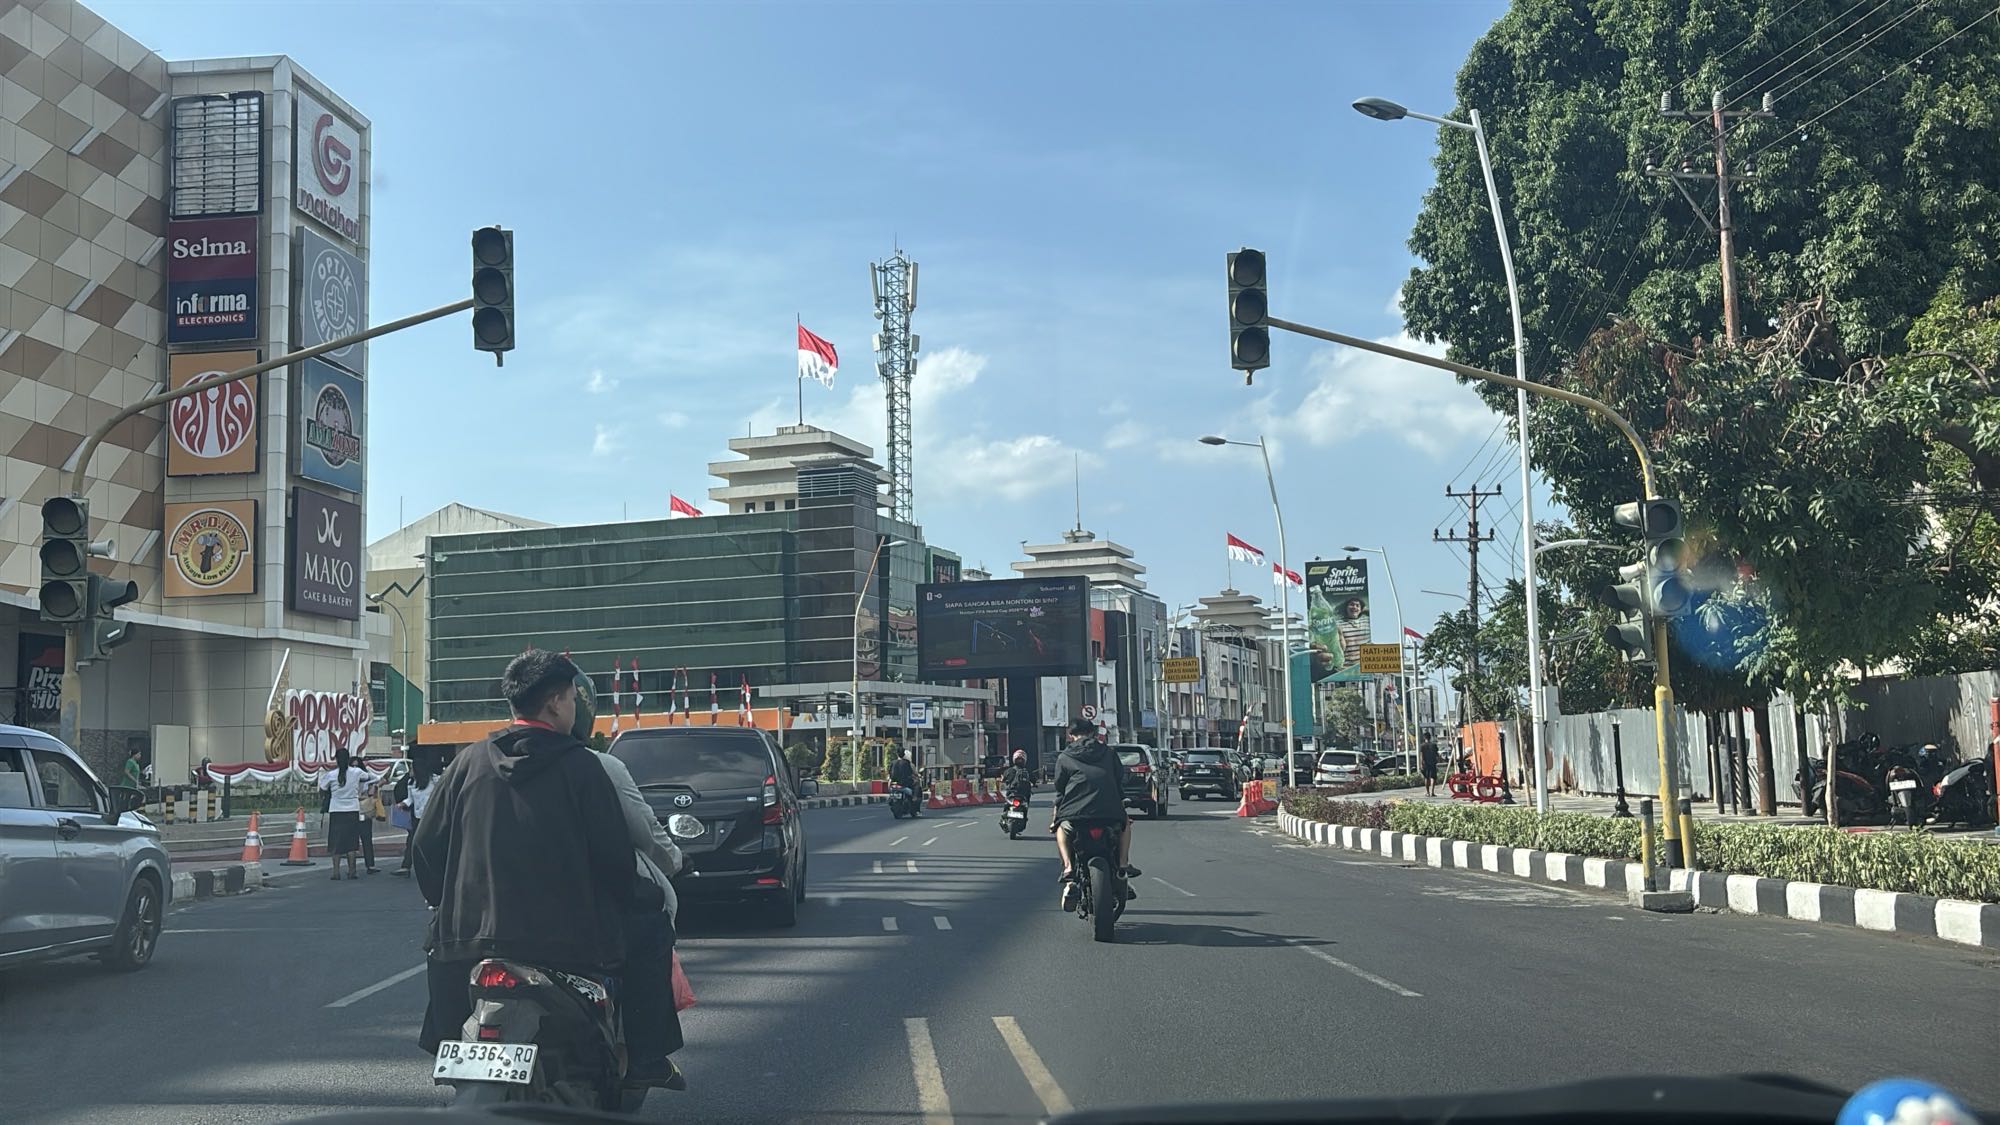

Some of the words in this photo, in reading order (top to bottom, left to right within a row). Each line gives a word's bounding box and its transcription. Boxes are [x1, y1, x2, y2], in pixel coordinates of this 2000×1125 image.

[299, 187, 360, 243] matahari
[173, 237, 247, 258] Selma
[318, 257, 353, 293] OPTIK
[177, 293, 248, 314] informa
[179, 314, 244, 325] ELECTRONICS
[183, 557, 202, 578] Always
[218, 554, 236, 577] Prices
[304, 552, 353, 593] MAKO
[1329, 565, 1359, 579] Sprite
[1322, 576, 1344, 587] Nipis
[1345, 575, 1366, 585] Mint
[303, 590, 321, 602] CAKE
[322, 594, 327, 603] &
[328, 595, 353, 607] BAKERY
[1166, 660, 1197, 668] HATI-HATI
[29, 667, 62, 692] Pizz
[440, 1043, 460, 1060] DB
[468, 1045, 506, 1061] 5364
